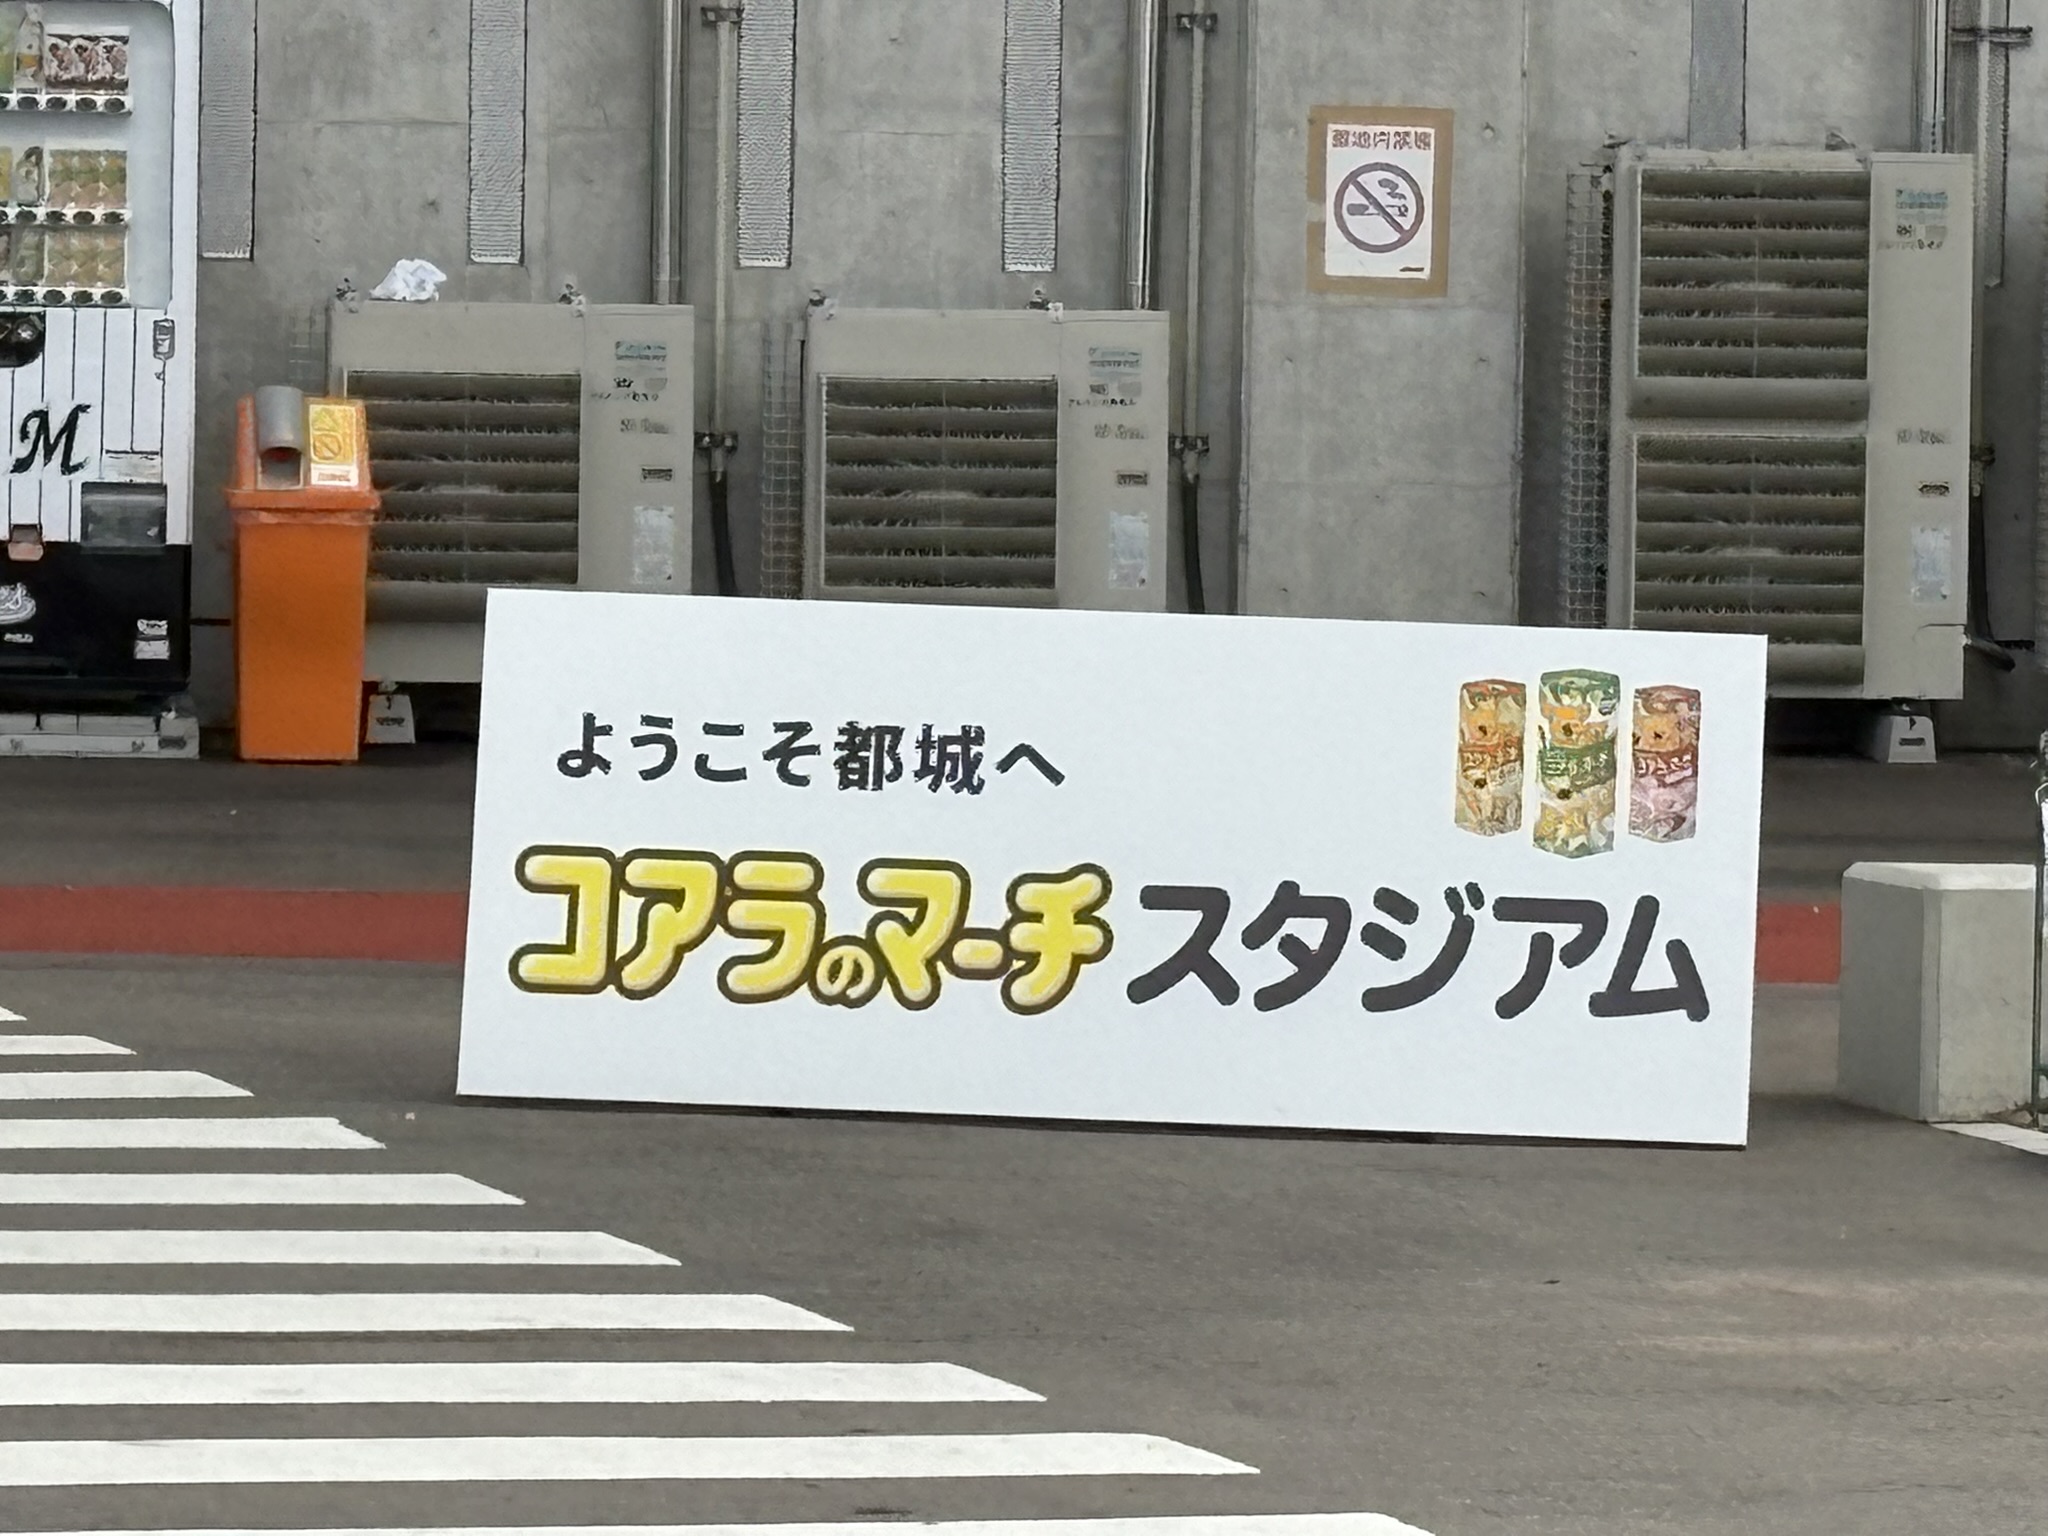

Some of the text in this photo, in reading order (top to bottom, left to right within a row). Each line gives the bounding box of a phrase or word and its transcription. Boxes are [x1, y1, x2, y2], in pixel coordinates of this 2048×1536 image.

[556, 712, 1066, 795] ようこそ都城へ
